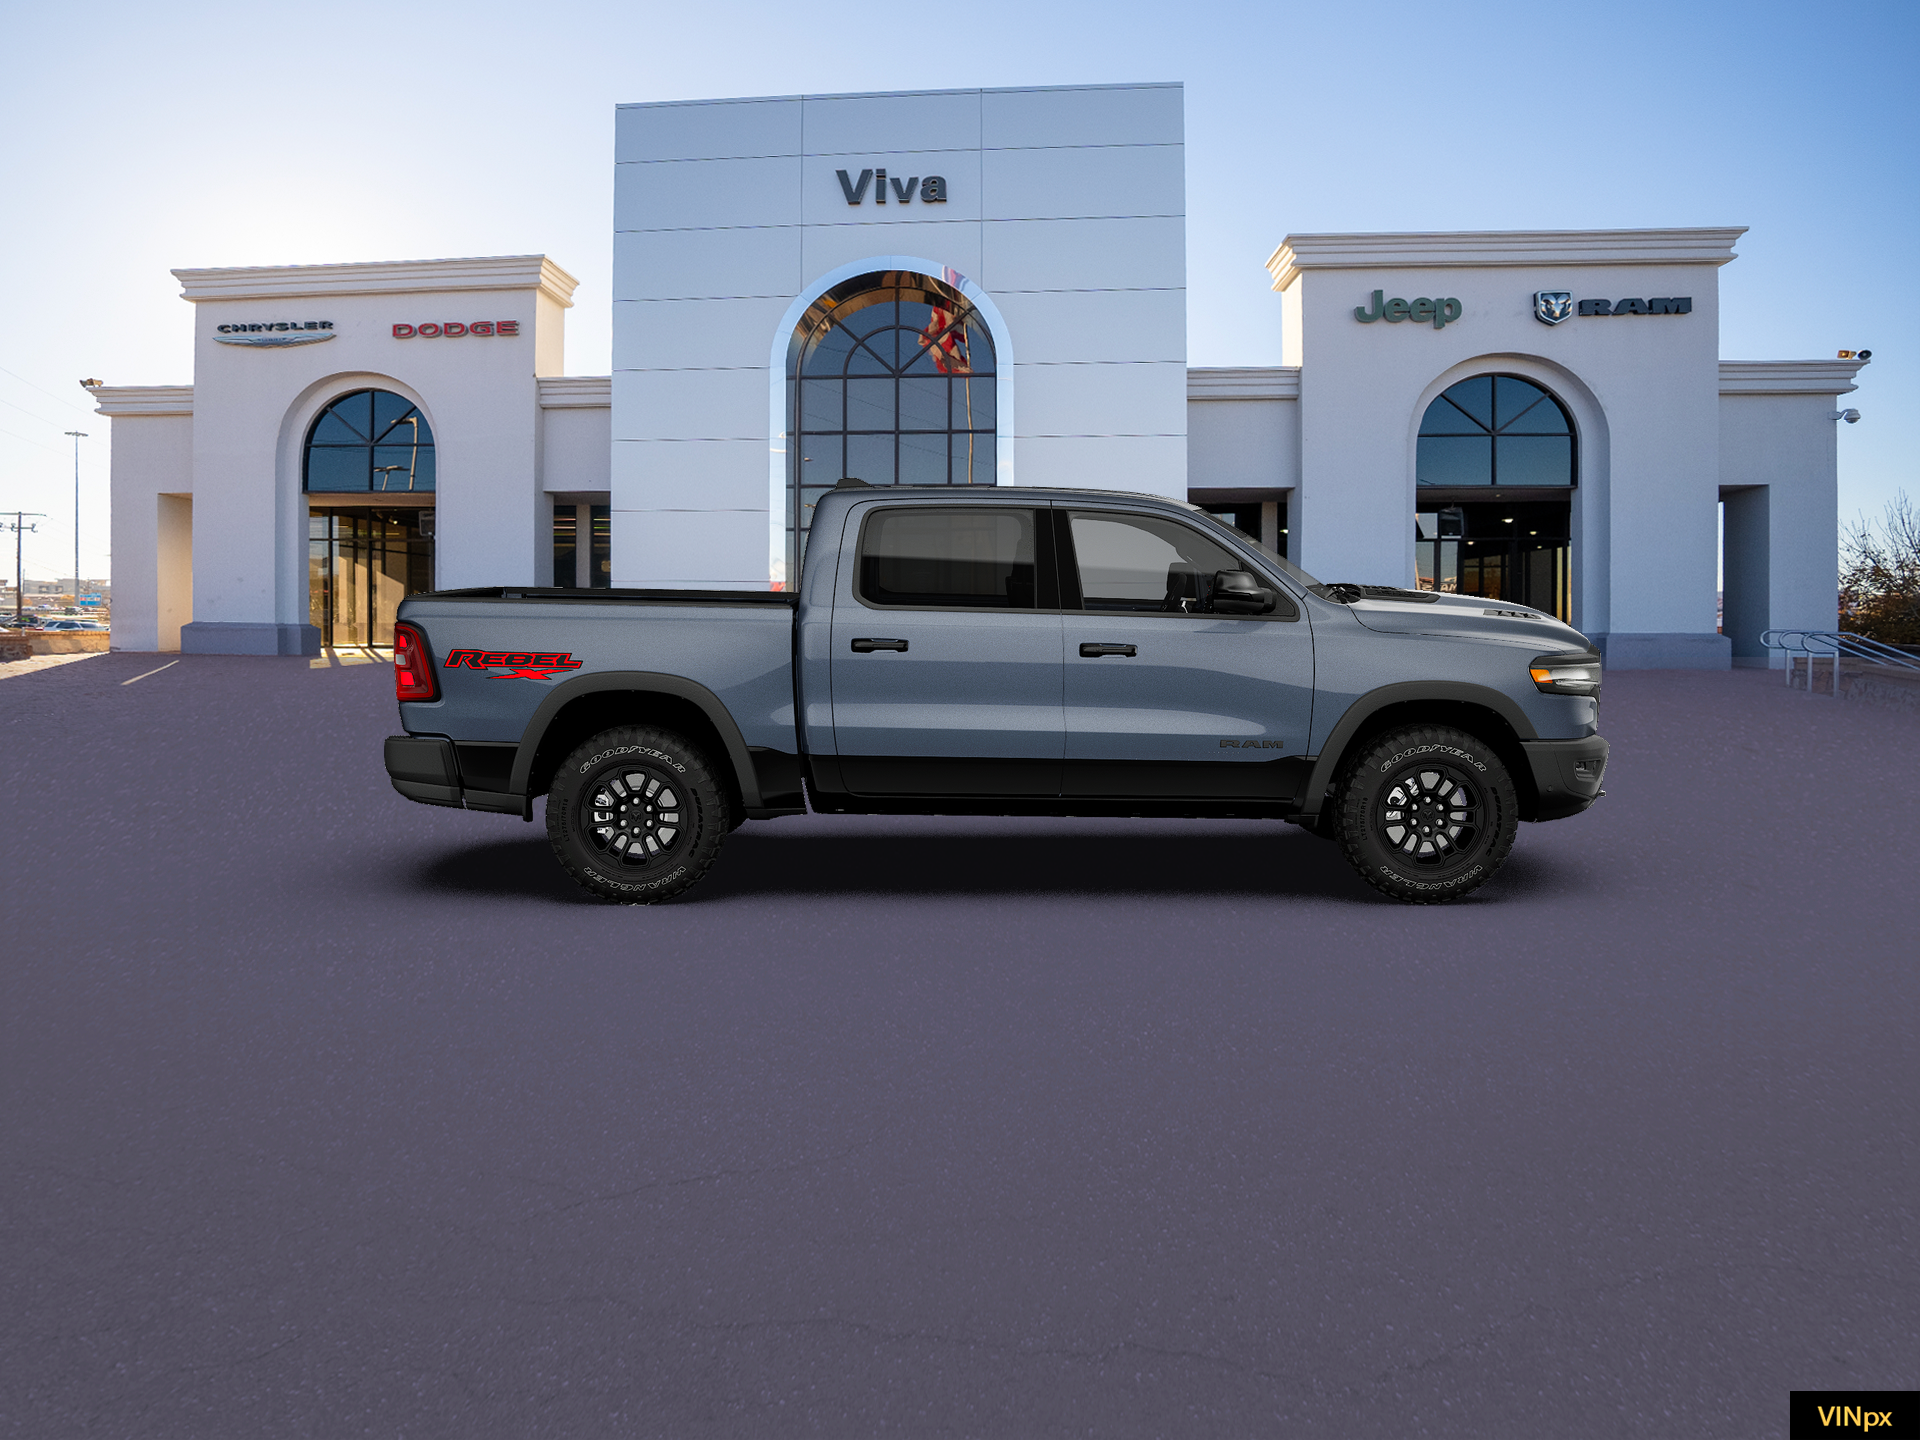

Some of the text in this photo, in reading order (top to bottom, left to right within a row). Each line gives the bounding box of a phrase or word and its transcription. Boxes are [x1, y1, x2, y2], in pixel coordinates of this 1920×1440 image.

[835, 168, 949, 205] Viva
[1354, 289, 1463, 330] Jeep
[1578, 296, 1692, 317] RAM
[217, 320, 334, 334] CHRYSLER
[392, 320, 520, 339] DODGE
[444, 649, 583, 670] REBEL
[486, 667, 574, 680] X
[1219, 739, 1284, 749] RAM
[579, 745, 687, 774] GOODYEAR
[1380, 744, 1488, 773] GOODYEAR
[583, 865, 686, 892] WRANGLER
[1379, 864, 1484, 891] WRANGLER
